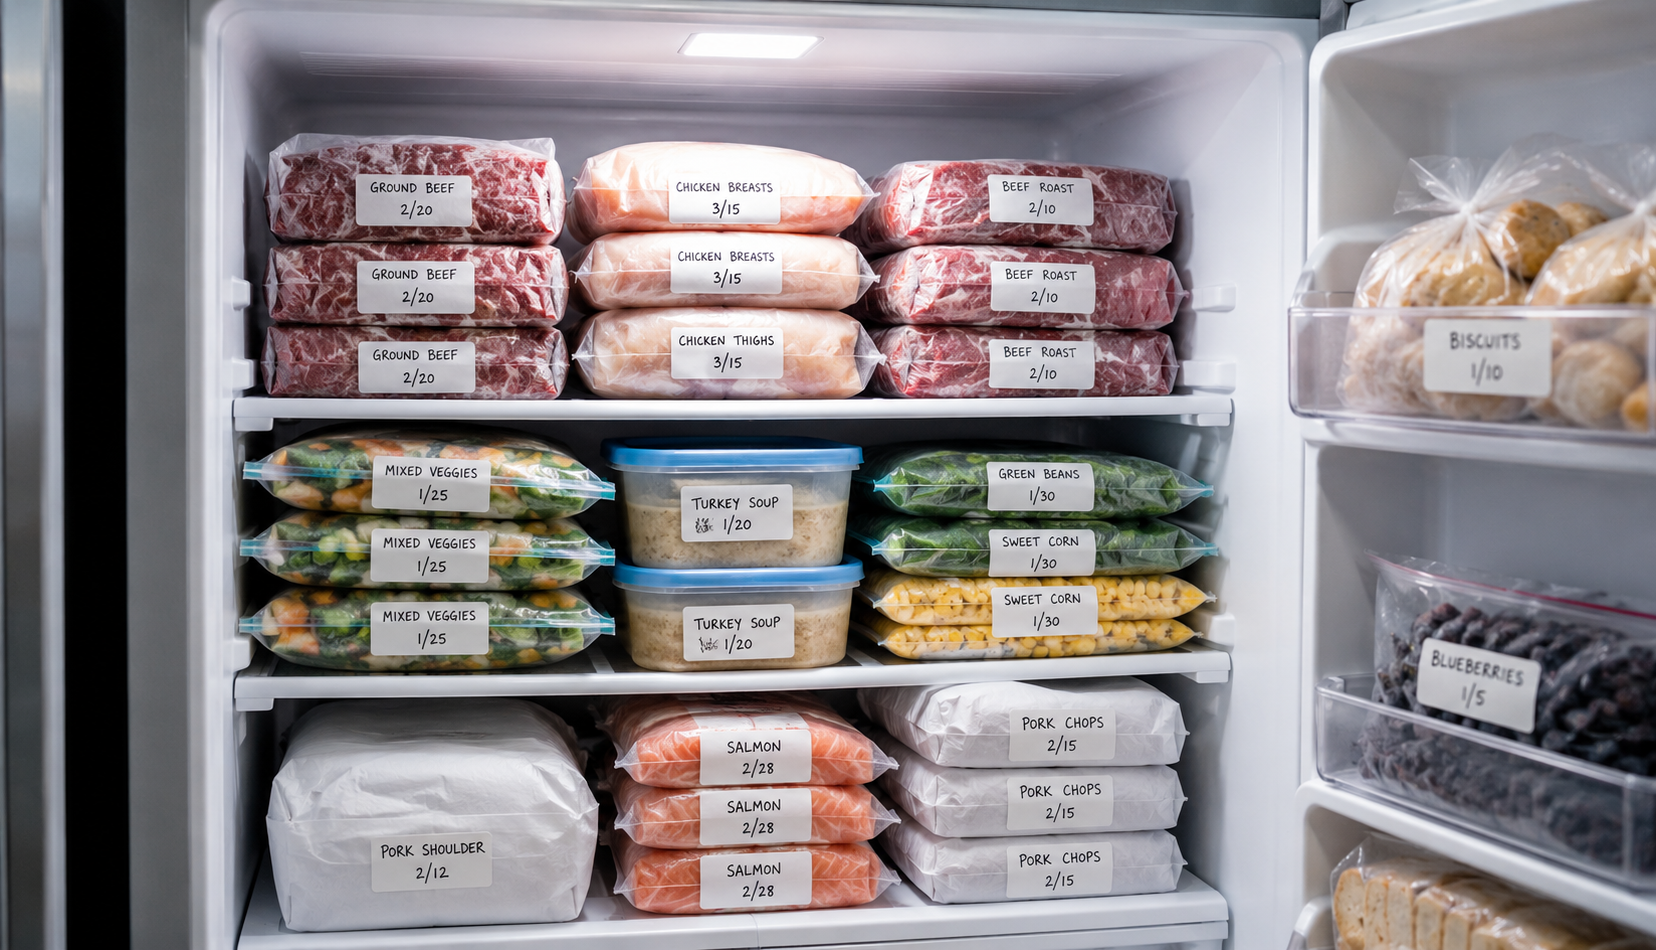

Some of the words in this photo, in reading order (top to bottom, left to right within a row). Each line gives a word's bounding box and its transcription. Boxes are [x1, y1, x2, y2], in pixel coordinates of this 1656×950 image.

[370, 181, 418, 194] GROUND
[425, 182, 455, 194] BEEF
[675, 181, 721, 193] CHICKEN
[727, 181, 774, 194] BREASTS
[1001, 180, 1030, 193] BEEF
[1039, 181, 1075, 194] ROAST
[400, 199, 433, 220] 2/20
[712, 198, 741, 219] 3/15
[1028, 198, 1056, 218] 2/10
[677, 250, 722, 263] CHICKEN
[729, 250, 775, 263] BREASTS
[371, 268, 419, 281] GROUND
[426, 268, 457, 281] BEEF
[713, 268, 742, 289] 3/15
[1004, 267, 1034, 280] BEEF
[1042, 269, 1078, 281] ROAST
[401, 286, 434, 307] 2/20
[1030, 287, 1059, 307] 2/10
[678, 334, 726, 347] CHICKEN
[732, 334, 775, 346] THIGHS
[1449, 331, 1520, 350] BISCUITS
[372, 348, 420, 362] GROUND
[427, 348, 458, 361] BEEF
[1003, 345, 1033, 358] BEEF
[1041, 346, 1077, 358] ROAST
[713, 351, 743, 374] 3/15
[1470, 357, 1504, 387] 1/10
[403, 367, 435, 388] 2/20
[1029, 363, 1058, 384] 2/10
[384, 464, 423, 477] MIXED
[429, 465, 478, 479] VEGGIES
[998, 467, 1036, 480] GREEN
[1043, 468, 1080, 480] BEANS
[419, 484, 448, 505] 1/25
[690, 496, 741, 511] TURKEY
[748, 496, 780, 509] SOUP
[1029, 485, 1056, 506] 1/30
[721, 514, 752, 536] 1/20
[383, 536, 421, 549] MIXED
[427, 537, 476, 550] VEGGIES
[1002, 535, 1041, 548] SWEET
[1048, 535, 1079, 547] CORN
[417, 555, 447, 577] 1/25
[1030, 553, 1058, 573] 1/30
[1004, 593, 1043, 606] SWEET
[1050, 592, 1081, 605] CORN
[382, 610, 421, 623] MIXED
[426, 609, 476, 622] VEGGIES
[693, 617, 743, 631] TURKEY
[750, 615, 781, 629] SOUP
[1033, 611, 1060, 632] 1/30
[417, 628, 447, 650] 1/25
[723, 633, 753, 655] 1/20
[1431, 650, 1524, 687] BLUEBERRIES
[1462, 683, 1486, 709] 1/5
[1021, 716, 1056, 731] PORK
[1064, 715, 1105, 729] CHOPS
[726, 739, 782, 755] SALMON
[1047, 734, 1077, 756] 2/15
[741, 758, 774, 779] 2/28
[1019, 784, 1053, 800] PORK
[1062, 782, 1102, 797] CHOPS
[726, 798, 781, 814] SALMON
[1045, 802, 1075, 823] 2/15
[742, 817, 775, 838] 2/28
[380, 844, 415, 860] PORK
[421, 840, 486, 857] SHOULDER
[1018, 853, 1052, 868] PORK
[1062, 850, 1101, 865] CHOPS
[415, 861, 450, 885] 2/12
[726, 861, 781, 878] SALMON
[1044, 870, 1075, 891] 2/15
[742, 880, 775, 902] 2/28
